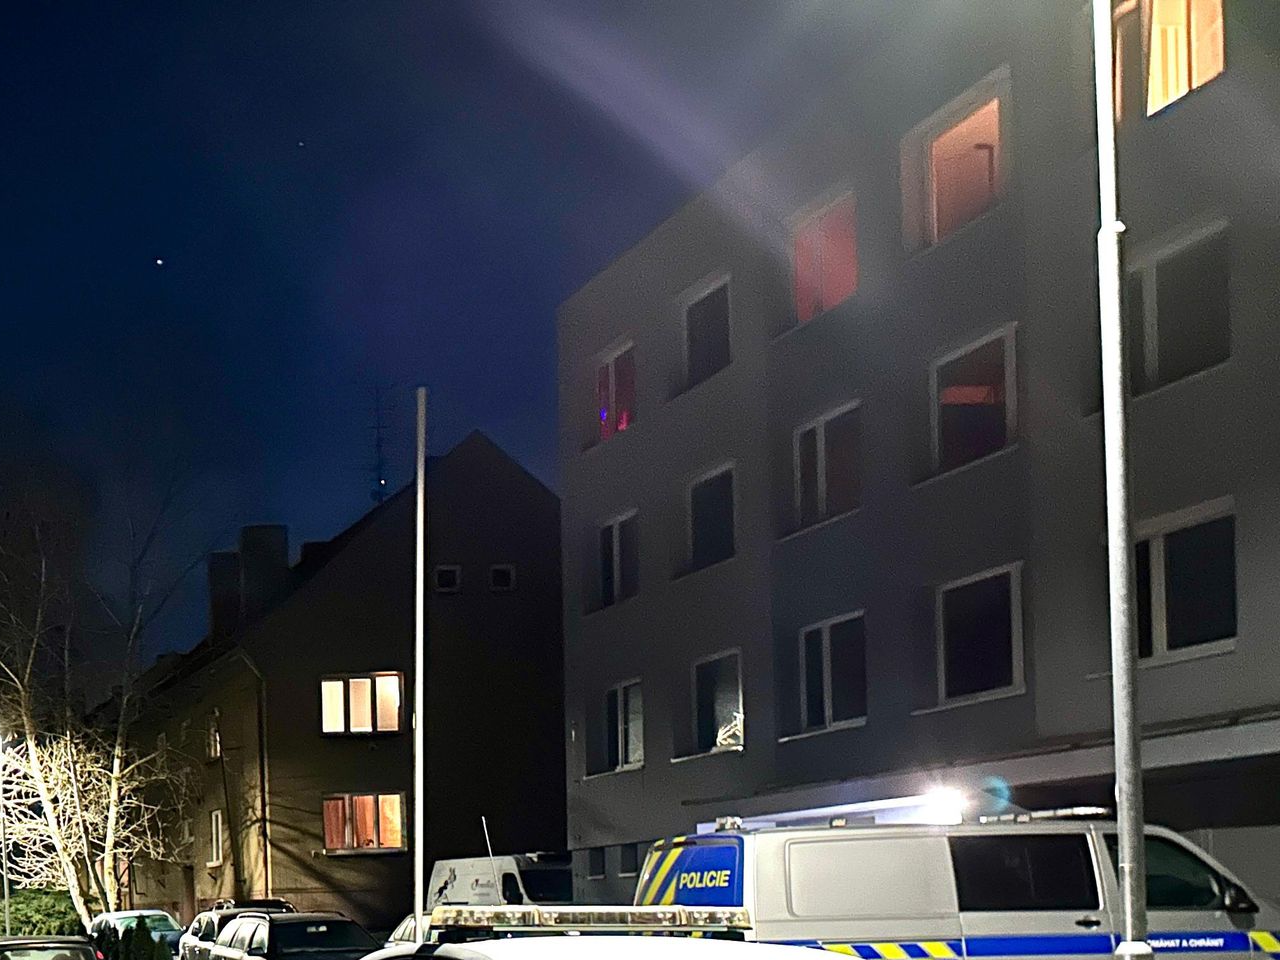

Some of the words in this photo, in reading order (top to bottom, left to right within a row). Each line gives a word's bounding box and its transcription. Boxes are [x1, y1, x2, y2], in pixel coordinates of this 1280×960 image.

[679, 870, 731, 889] POLICIE
[1182, 939, 1188, 947] A
[1189, 935, 1224, 949] CHRÁNIT
